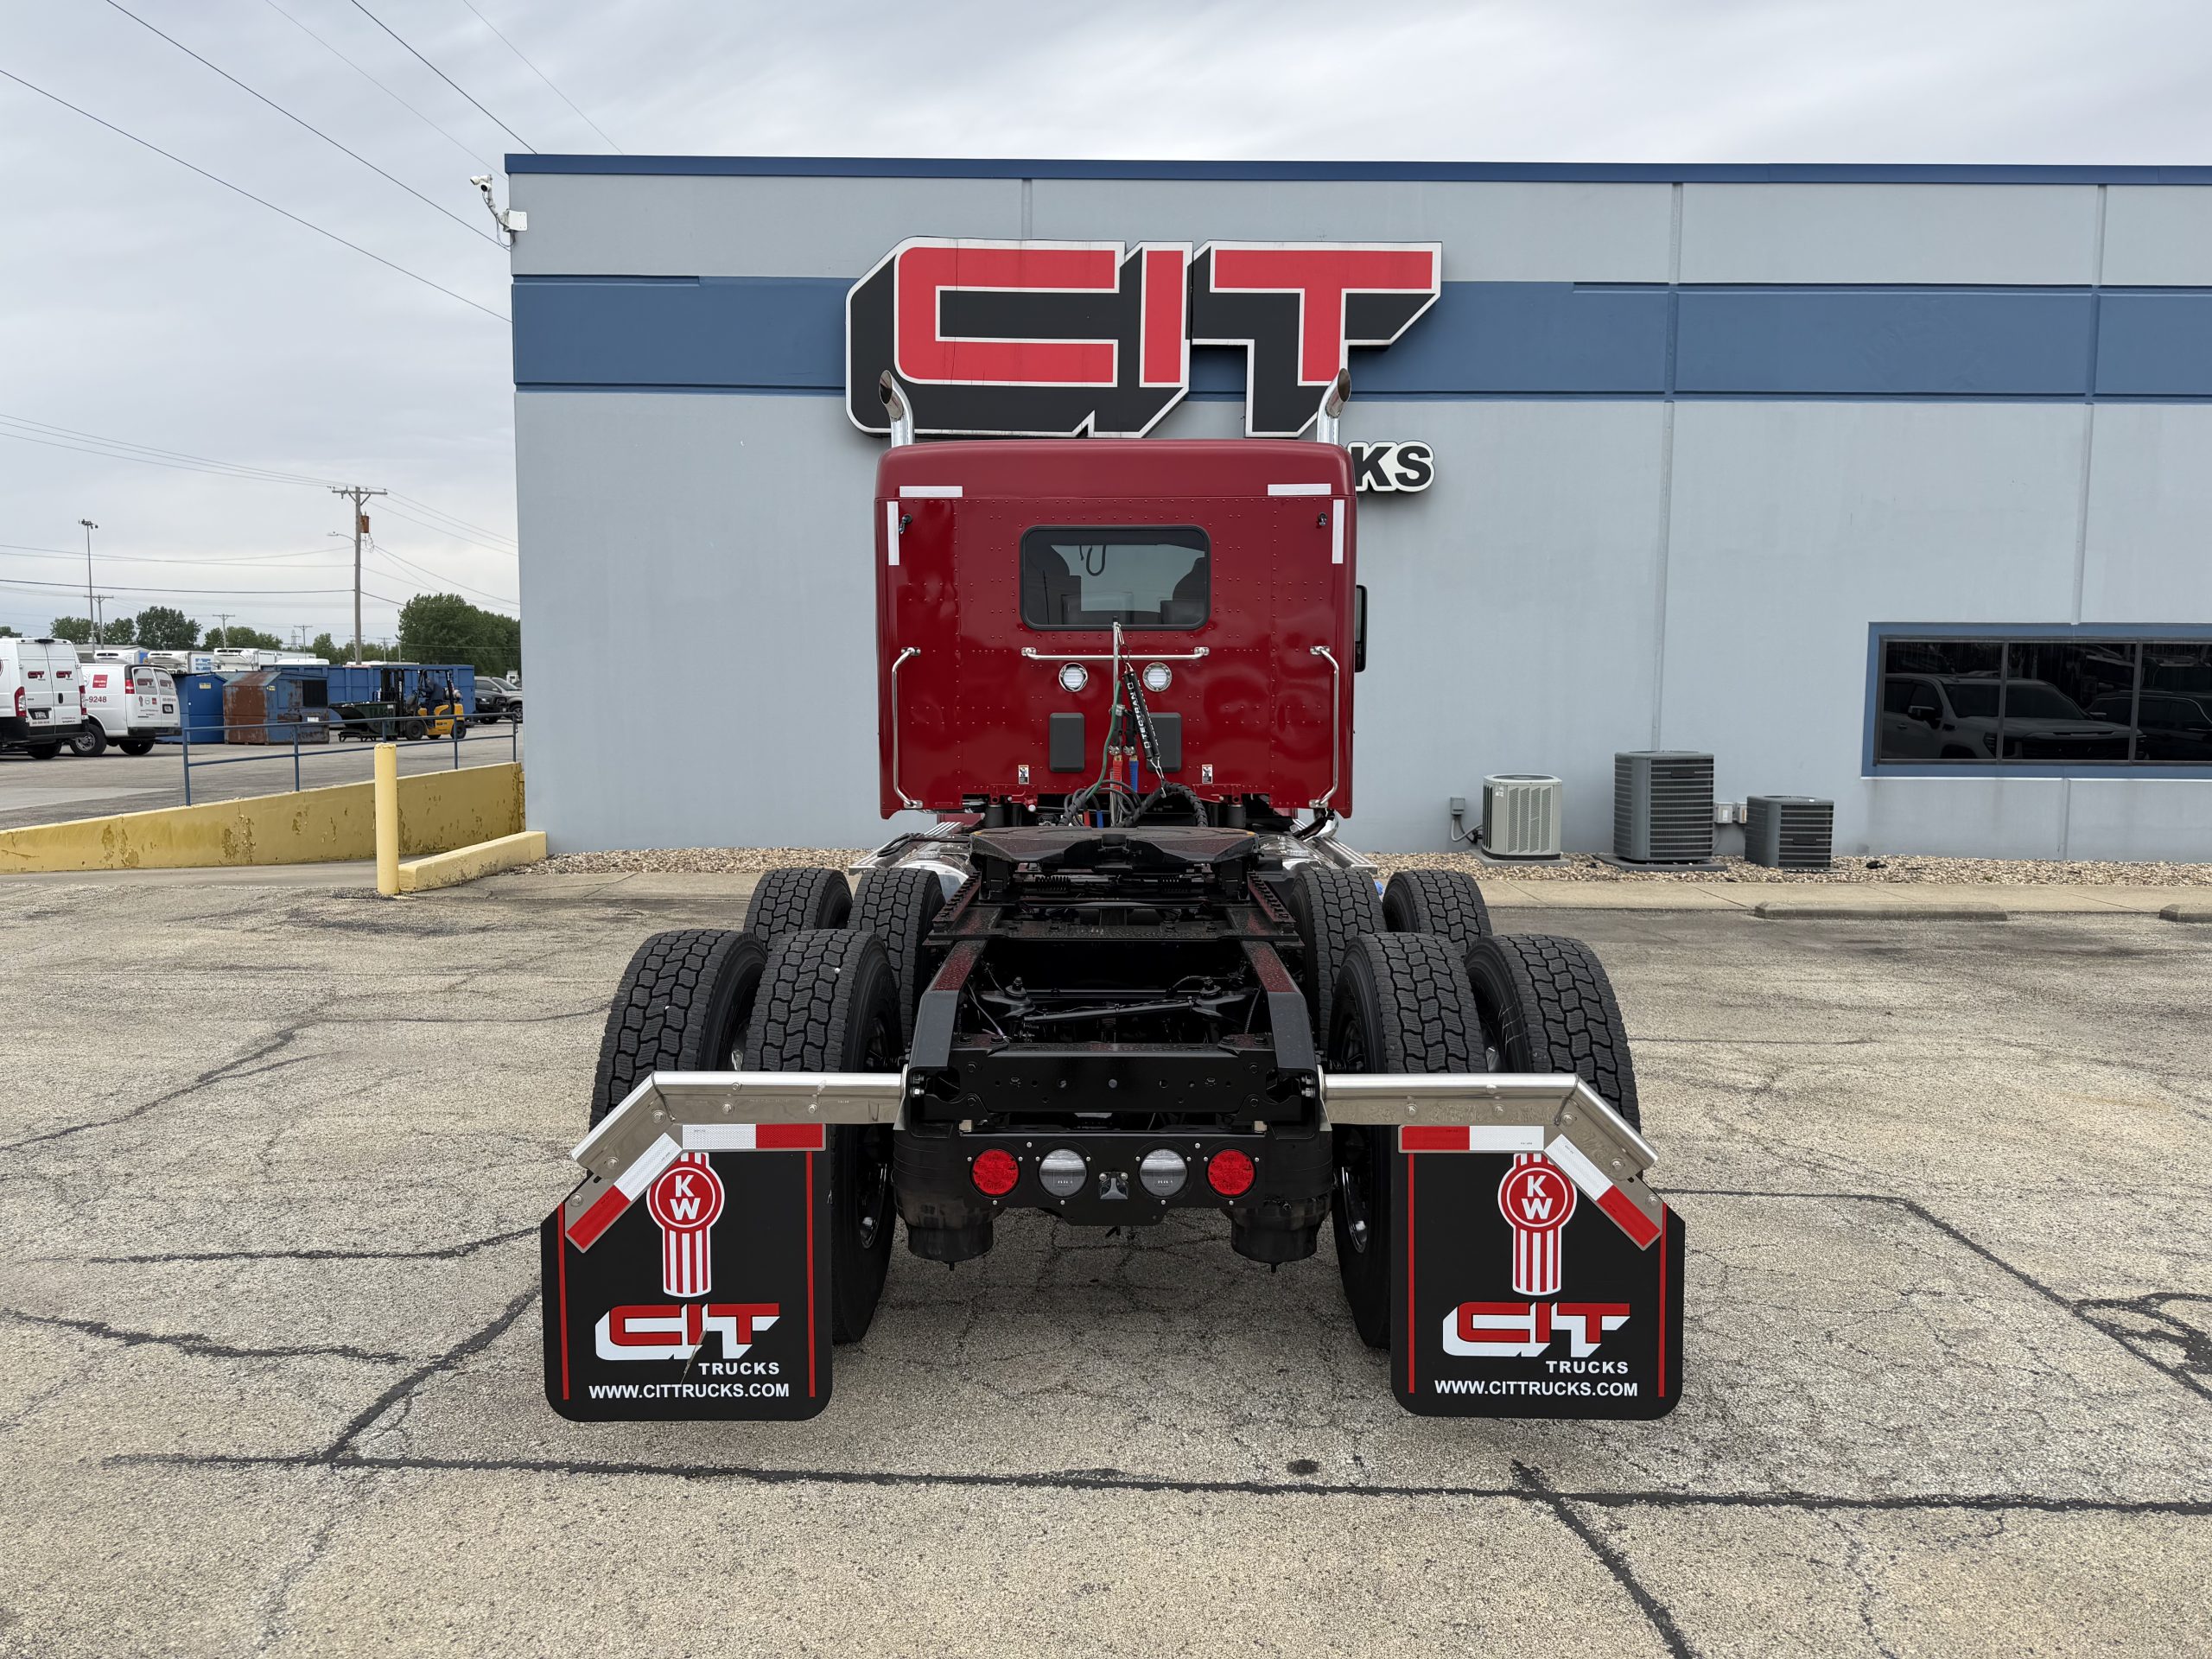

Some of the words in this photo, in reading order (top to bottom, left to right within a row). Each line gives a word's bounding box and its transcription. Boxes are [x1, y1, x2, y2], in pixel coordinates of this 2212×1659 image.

[845, 236, 1442, 439] CIT
[1130, 691, 1147, 739] TECTRAN
[595, 1303, 780, 1361] CIT
[1442, 1301, 1630, 1357] CIT
[698, 1362, 780, 1376] TRUCKS
[1546, 1361, 1630, 1374] TRUCKS
[588, 1383, 790, 1399] WWW.CITTRUCKS.COM
[1434, 1380, 1638, 1397] WWW.CITTRUCKS.COM
